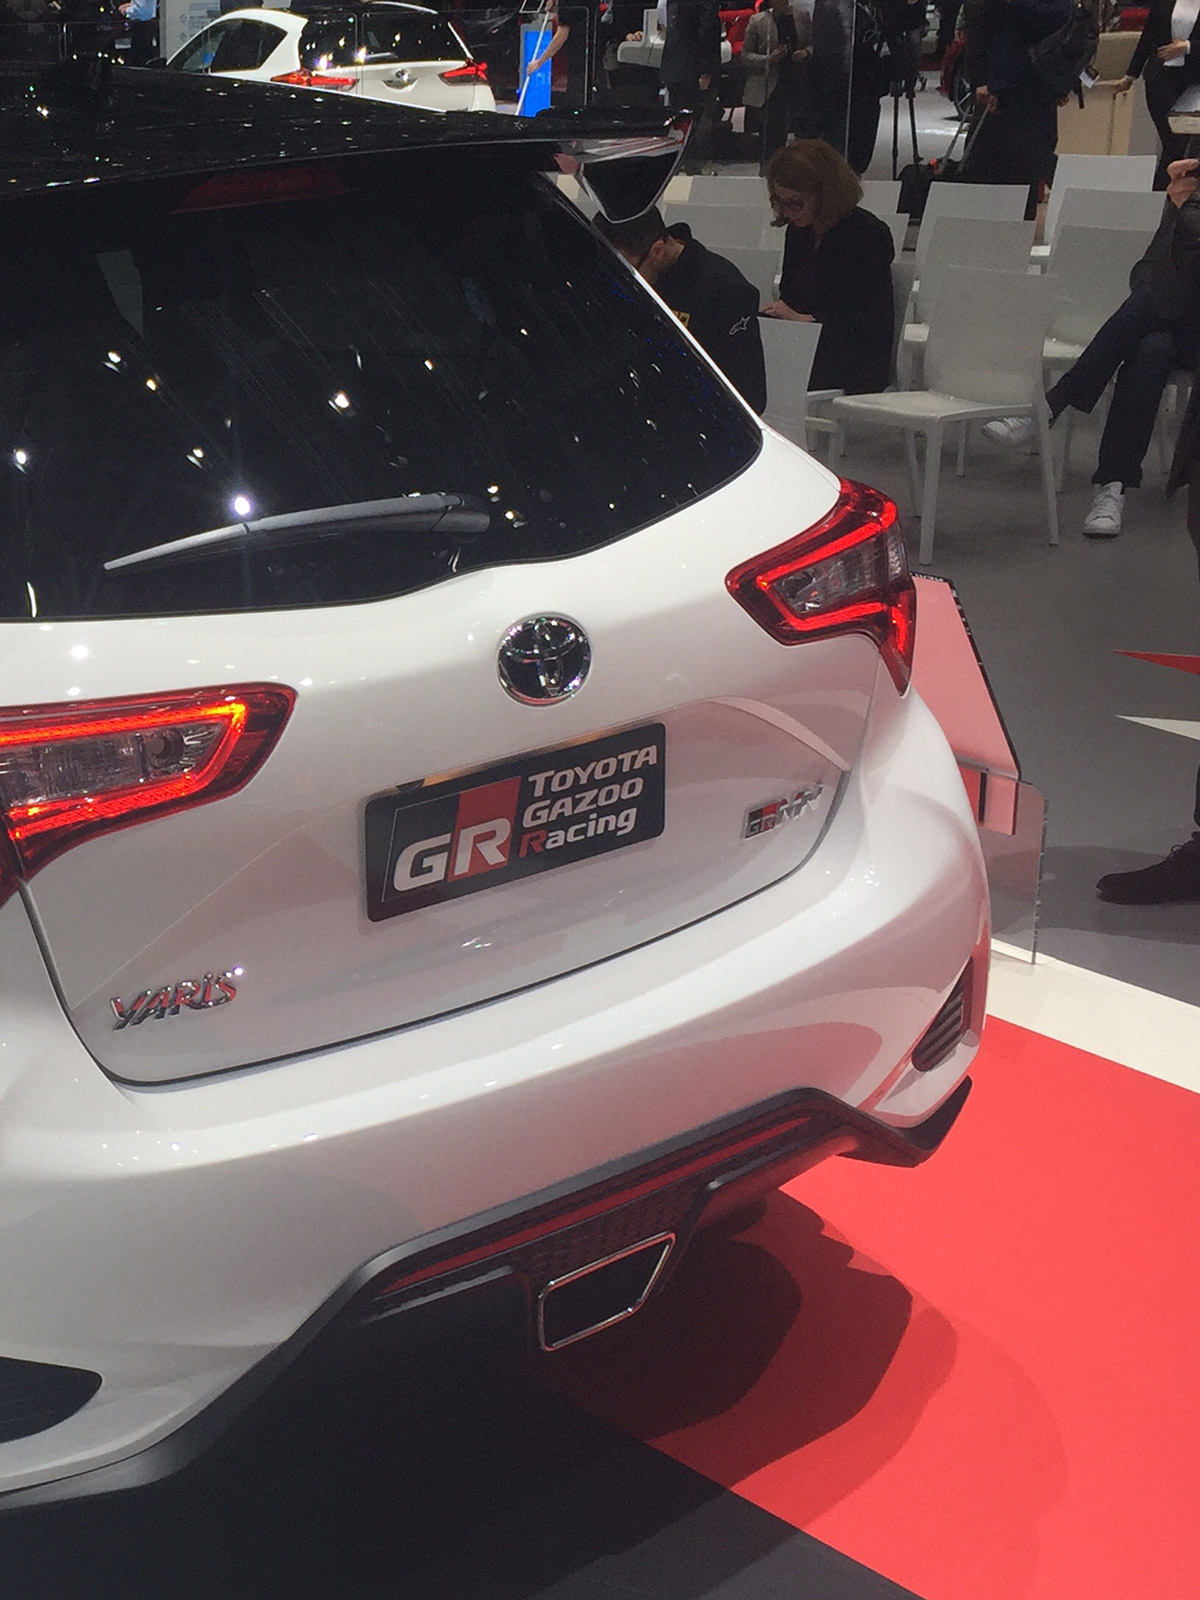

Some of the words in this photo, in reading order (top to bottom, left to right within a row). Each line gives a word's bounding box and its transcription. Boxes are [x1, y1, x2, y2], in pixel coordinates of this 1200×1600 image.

[528, 745, 657, 798] TOYOTA
[521, 779, 644, 828] GAZOO
[393, 818, 511, 891] GR
[519, 807, 636, 858] Racing
[110, 968, 243, 1030] YARIS
